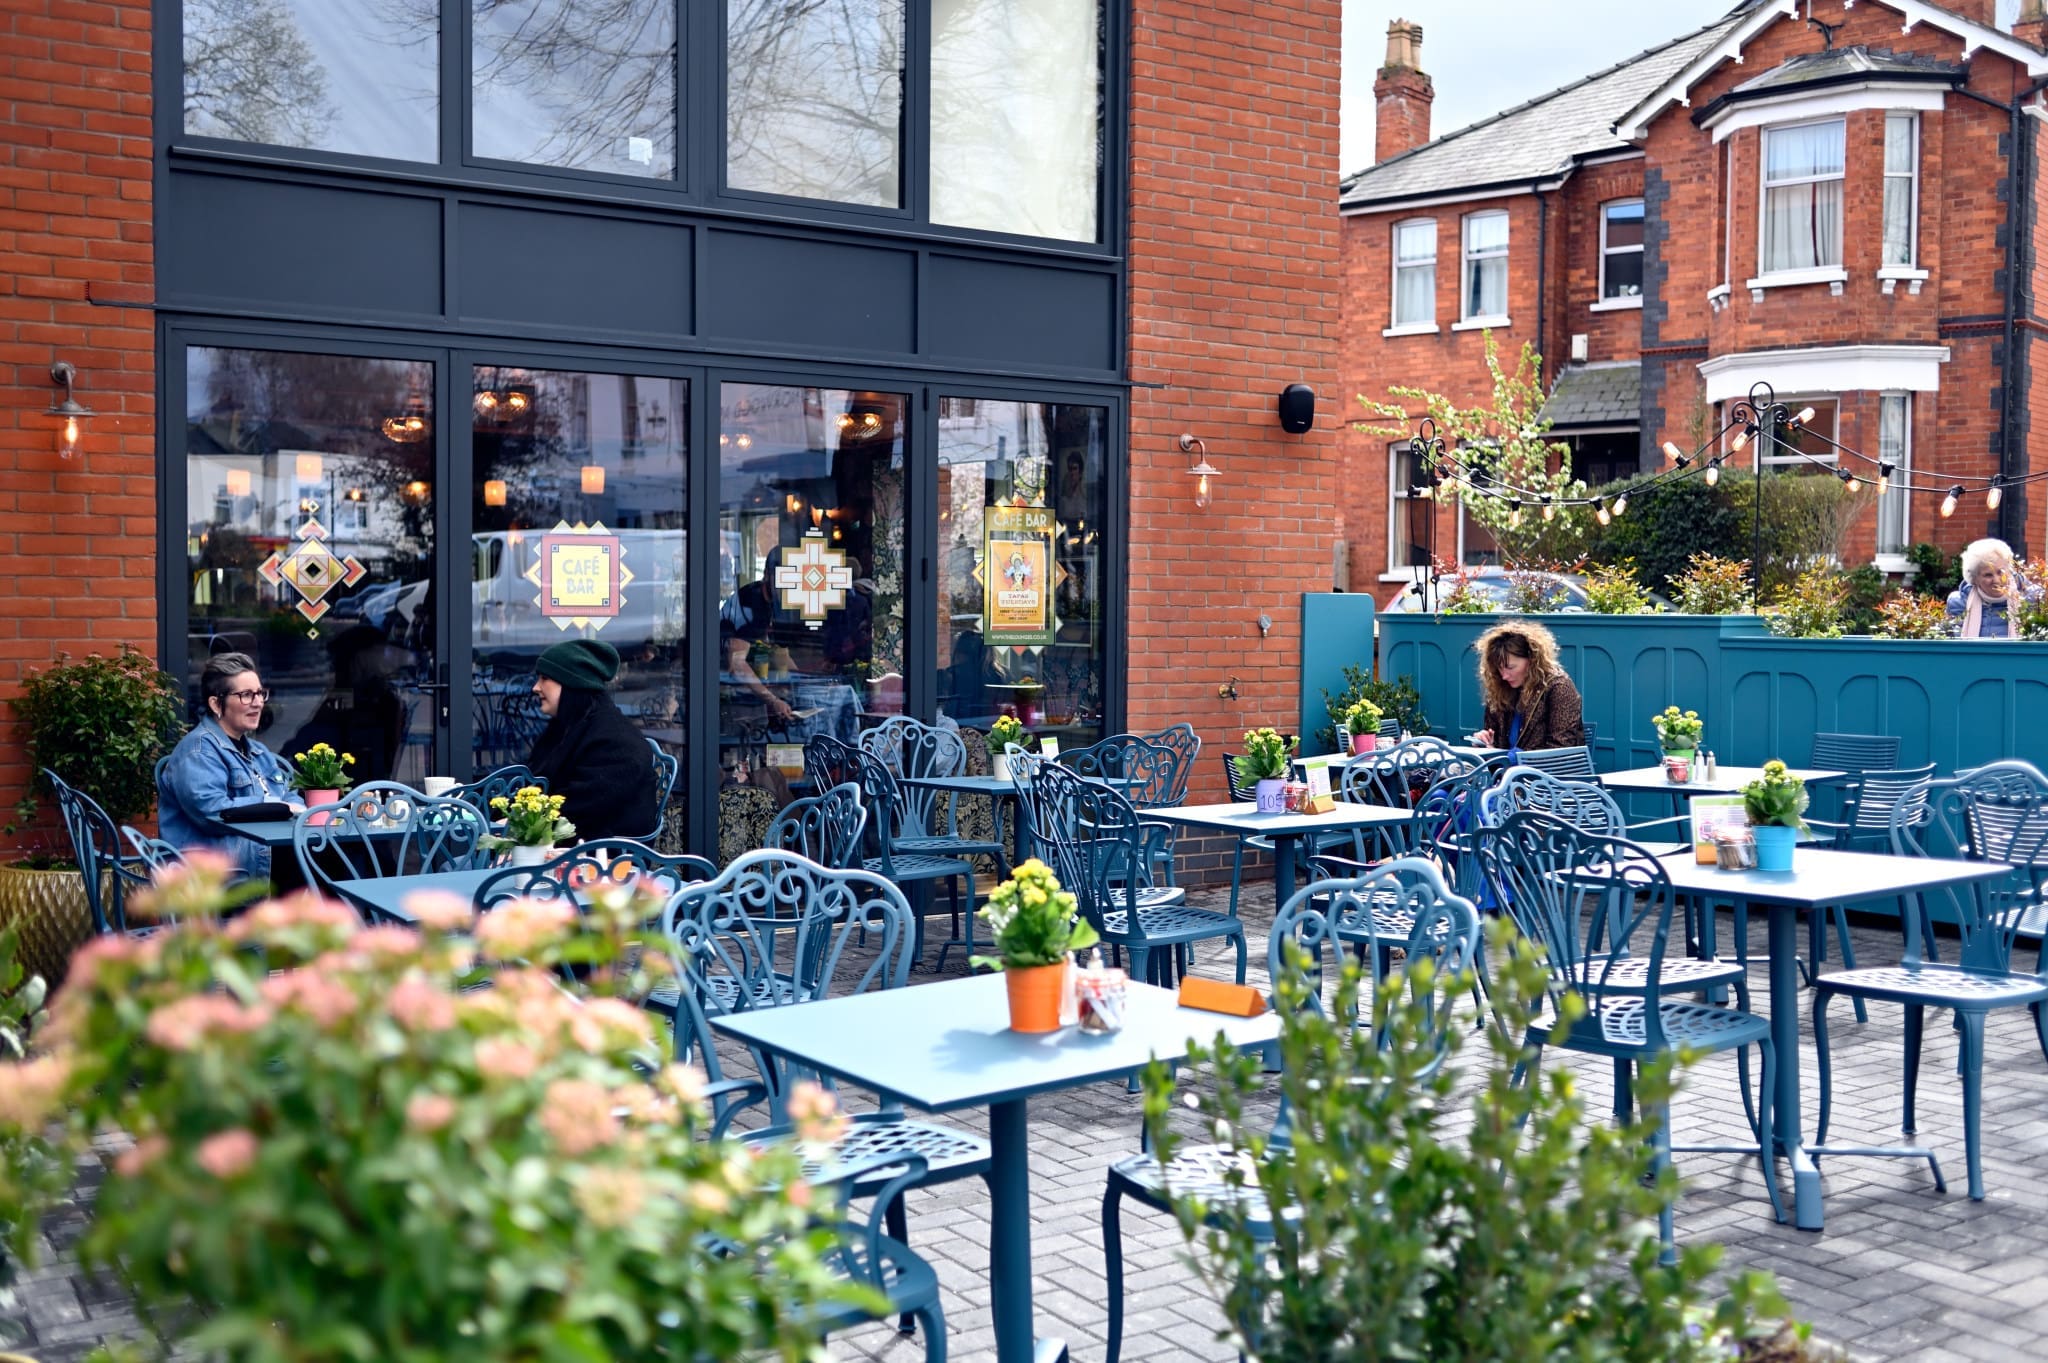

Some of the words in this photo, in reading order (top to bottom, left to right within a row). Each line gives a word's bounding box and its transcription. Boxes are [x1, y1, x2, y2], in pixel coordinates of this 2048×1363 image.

[1025, 513, 1047, 527] BAR
[562, 555, 600, 576] CAFÉ
[566, 578, 595, 594] BAR
[1260, 793, 1283, 811] 105
